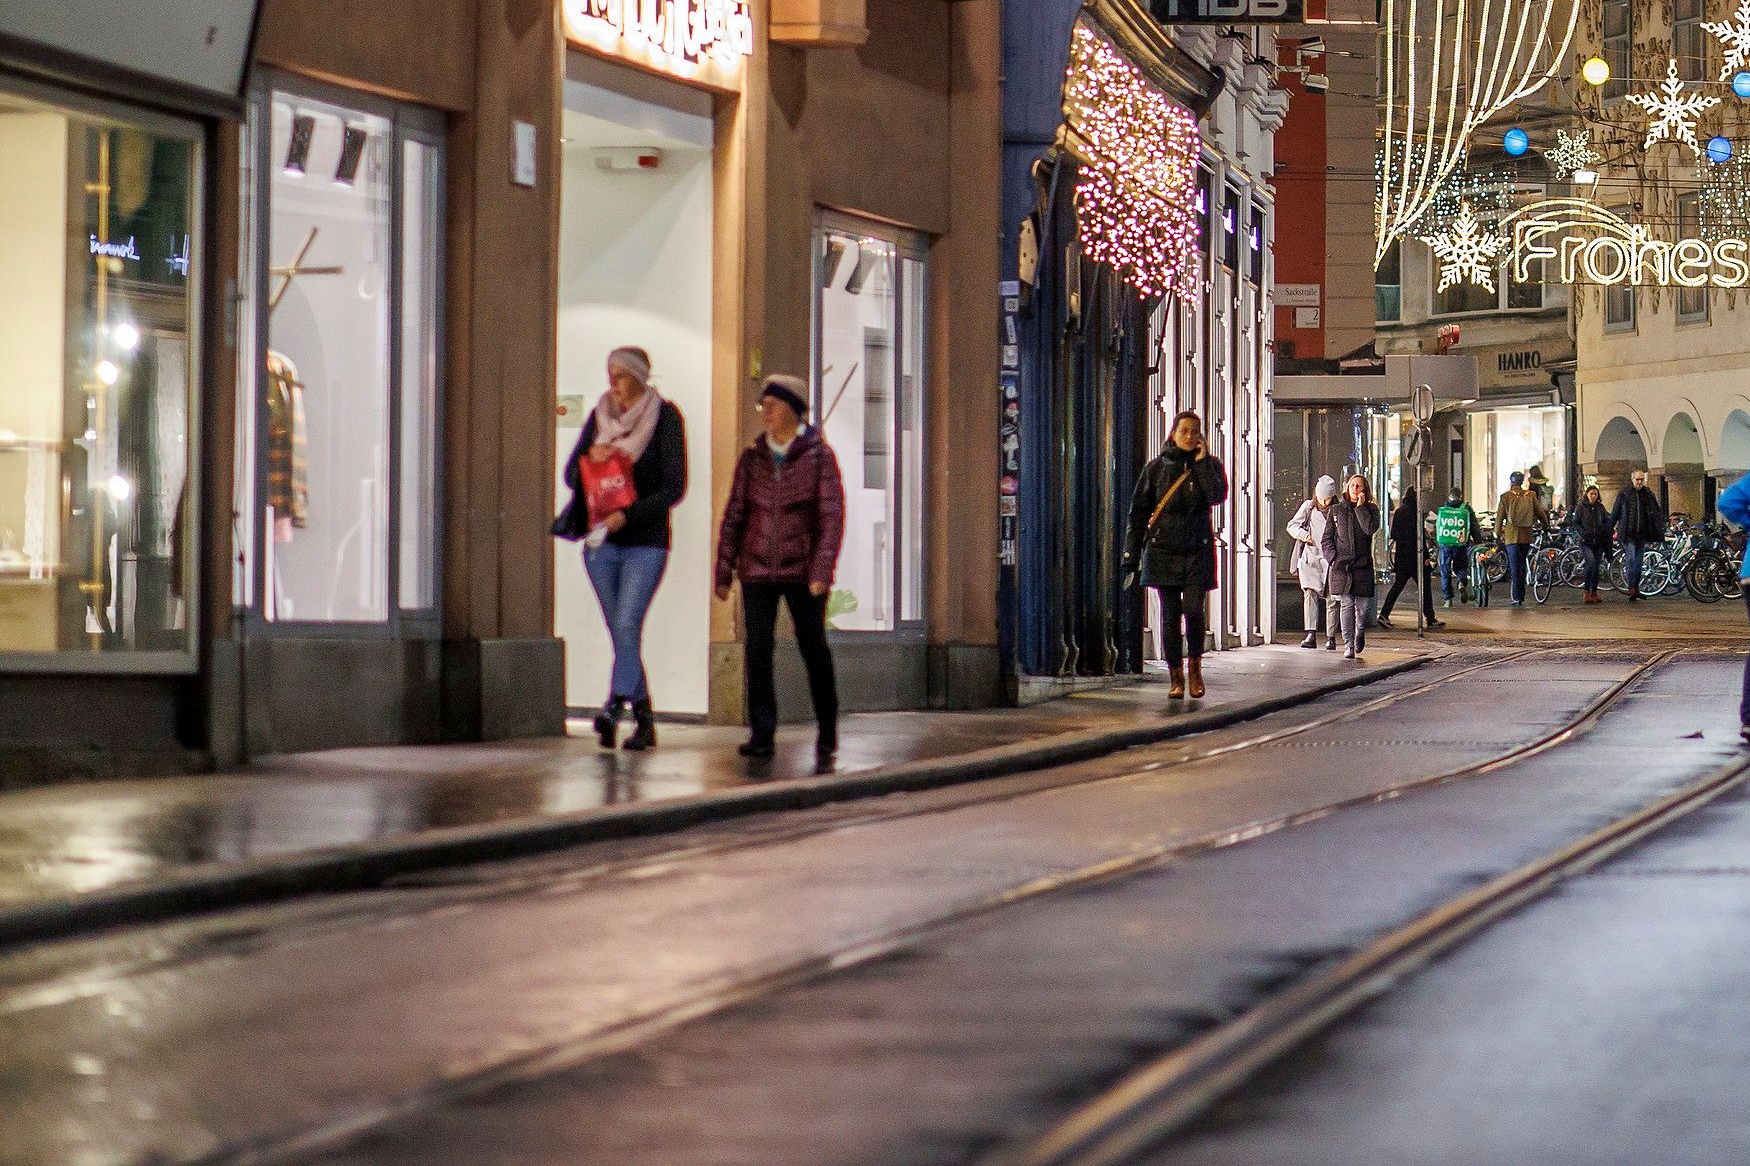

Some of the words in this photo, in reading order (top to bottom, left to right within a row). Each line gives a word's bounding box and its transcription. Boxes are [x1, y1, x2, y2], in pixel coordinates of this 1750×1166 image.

[1515, 220, 1749, 288] Frohes
[1313, 309, 1319, 321] 2
[1440, 516, 1465, 527] velo
[1439, 526, 1466, 538] food
